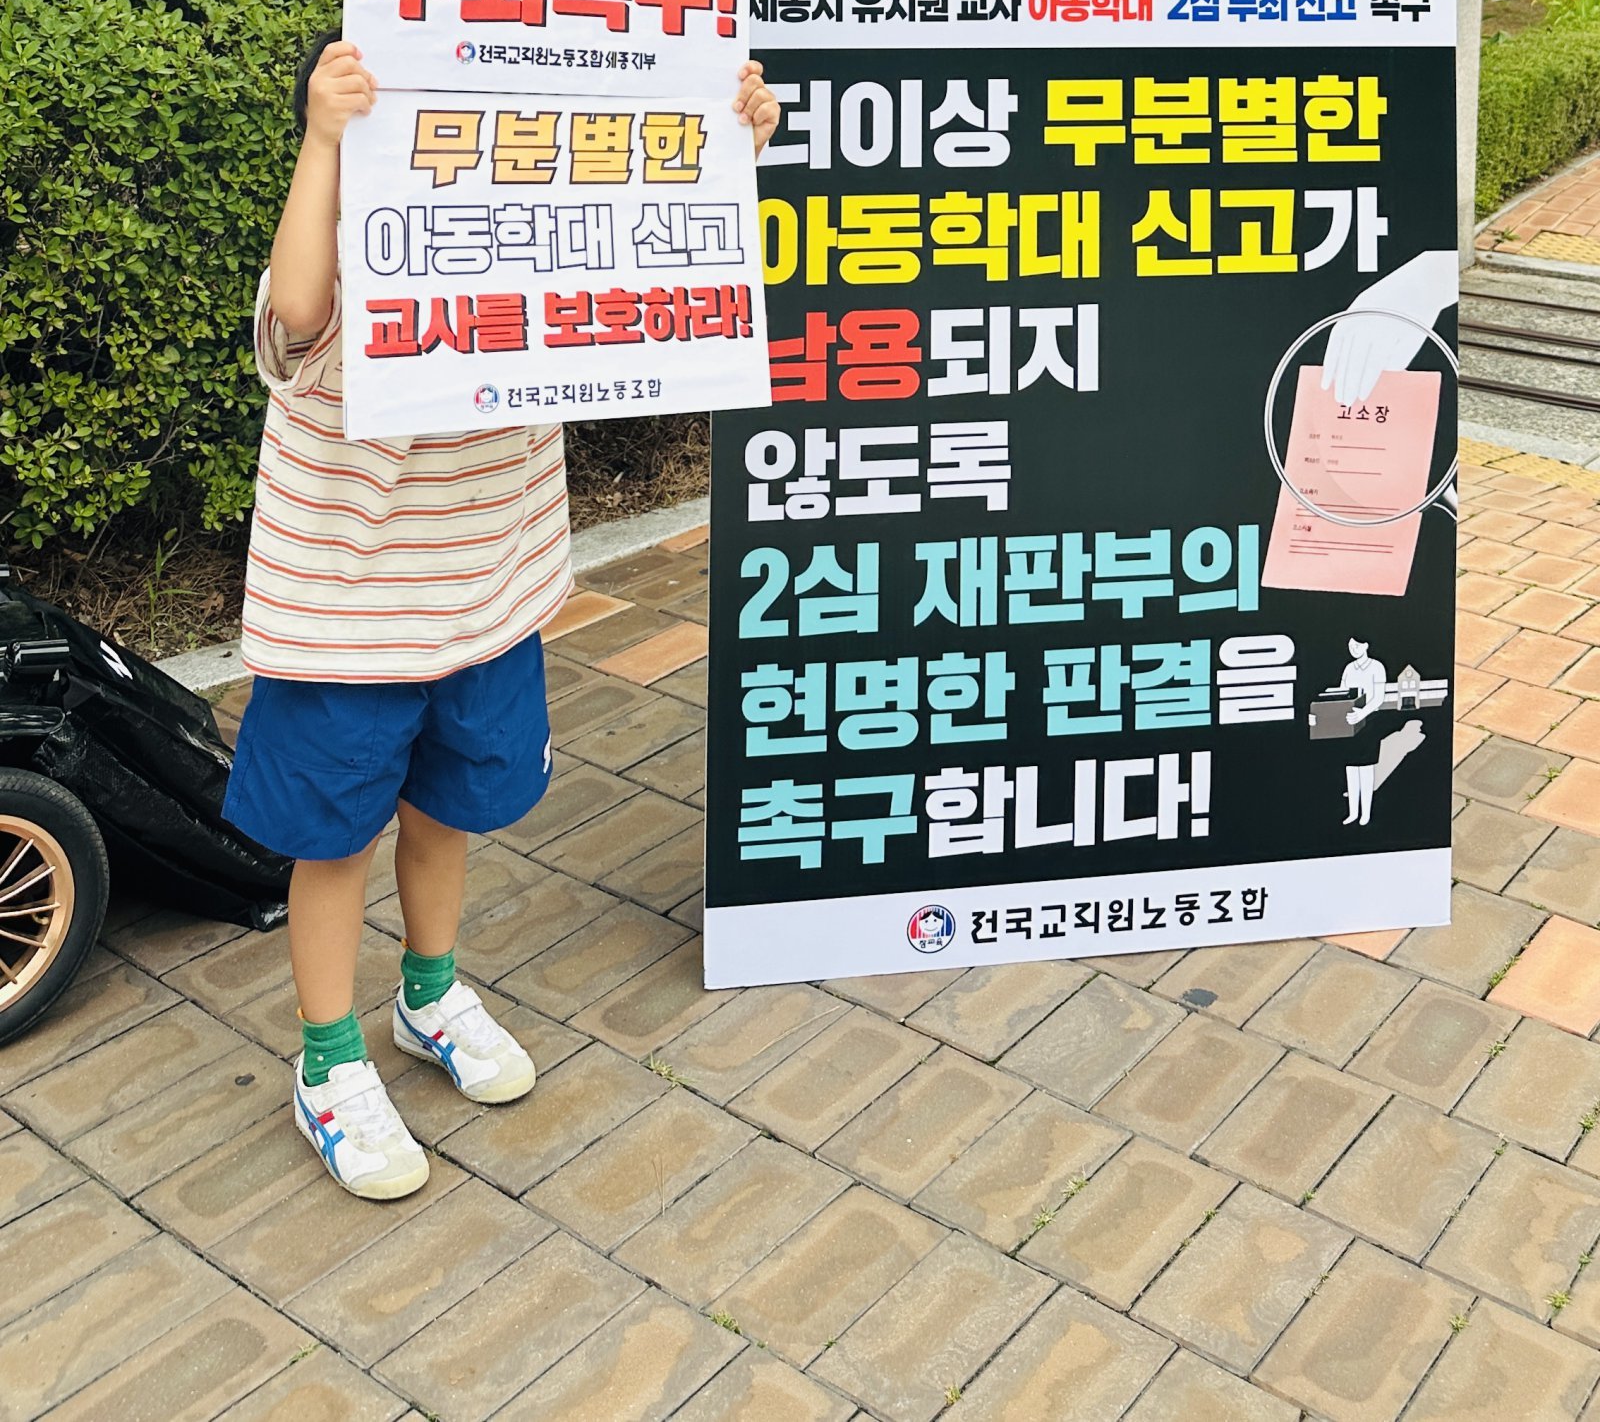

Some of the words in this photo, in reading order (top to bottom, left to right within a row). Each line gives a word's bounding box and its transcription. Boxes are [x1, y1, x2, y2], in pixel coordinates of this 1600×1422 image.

[410, 109, 707, 189] 무분별한
[1044, 74, 1388, 167] 무분별한
[364, 203, 615, 276] 아동학대
[632, 203, 745, 269] 신고
[758, 190, 1100, 285] 아동학대
[1130, 186, 1389, 280] 신고가
[364, 292, 529, 359] 교사를
[543, 284, 754, 349] 보호하라!
[507, 379, 662, 408] 전국교직원노동조합
[1337, 404, 1390, 424] 고소장
[743, 420, 1012, 523] 않도록
[737, 542, 881, 640] 2심
[912, 523, 1261, 630] 재판부의
[739, 650, 1016, 758] 현명한
[1041, 633, 1298, 738] 판결을
[736, 750, 1213, 870] 촉구합니다!
[971, 886, 1269, 945] 전국교직원노동조합
